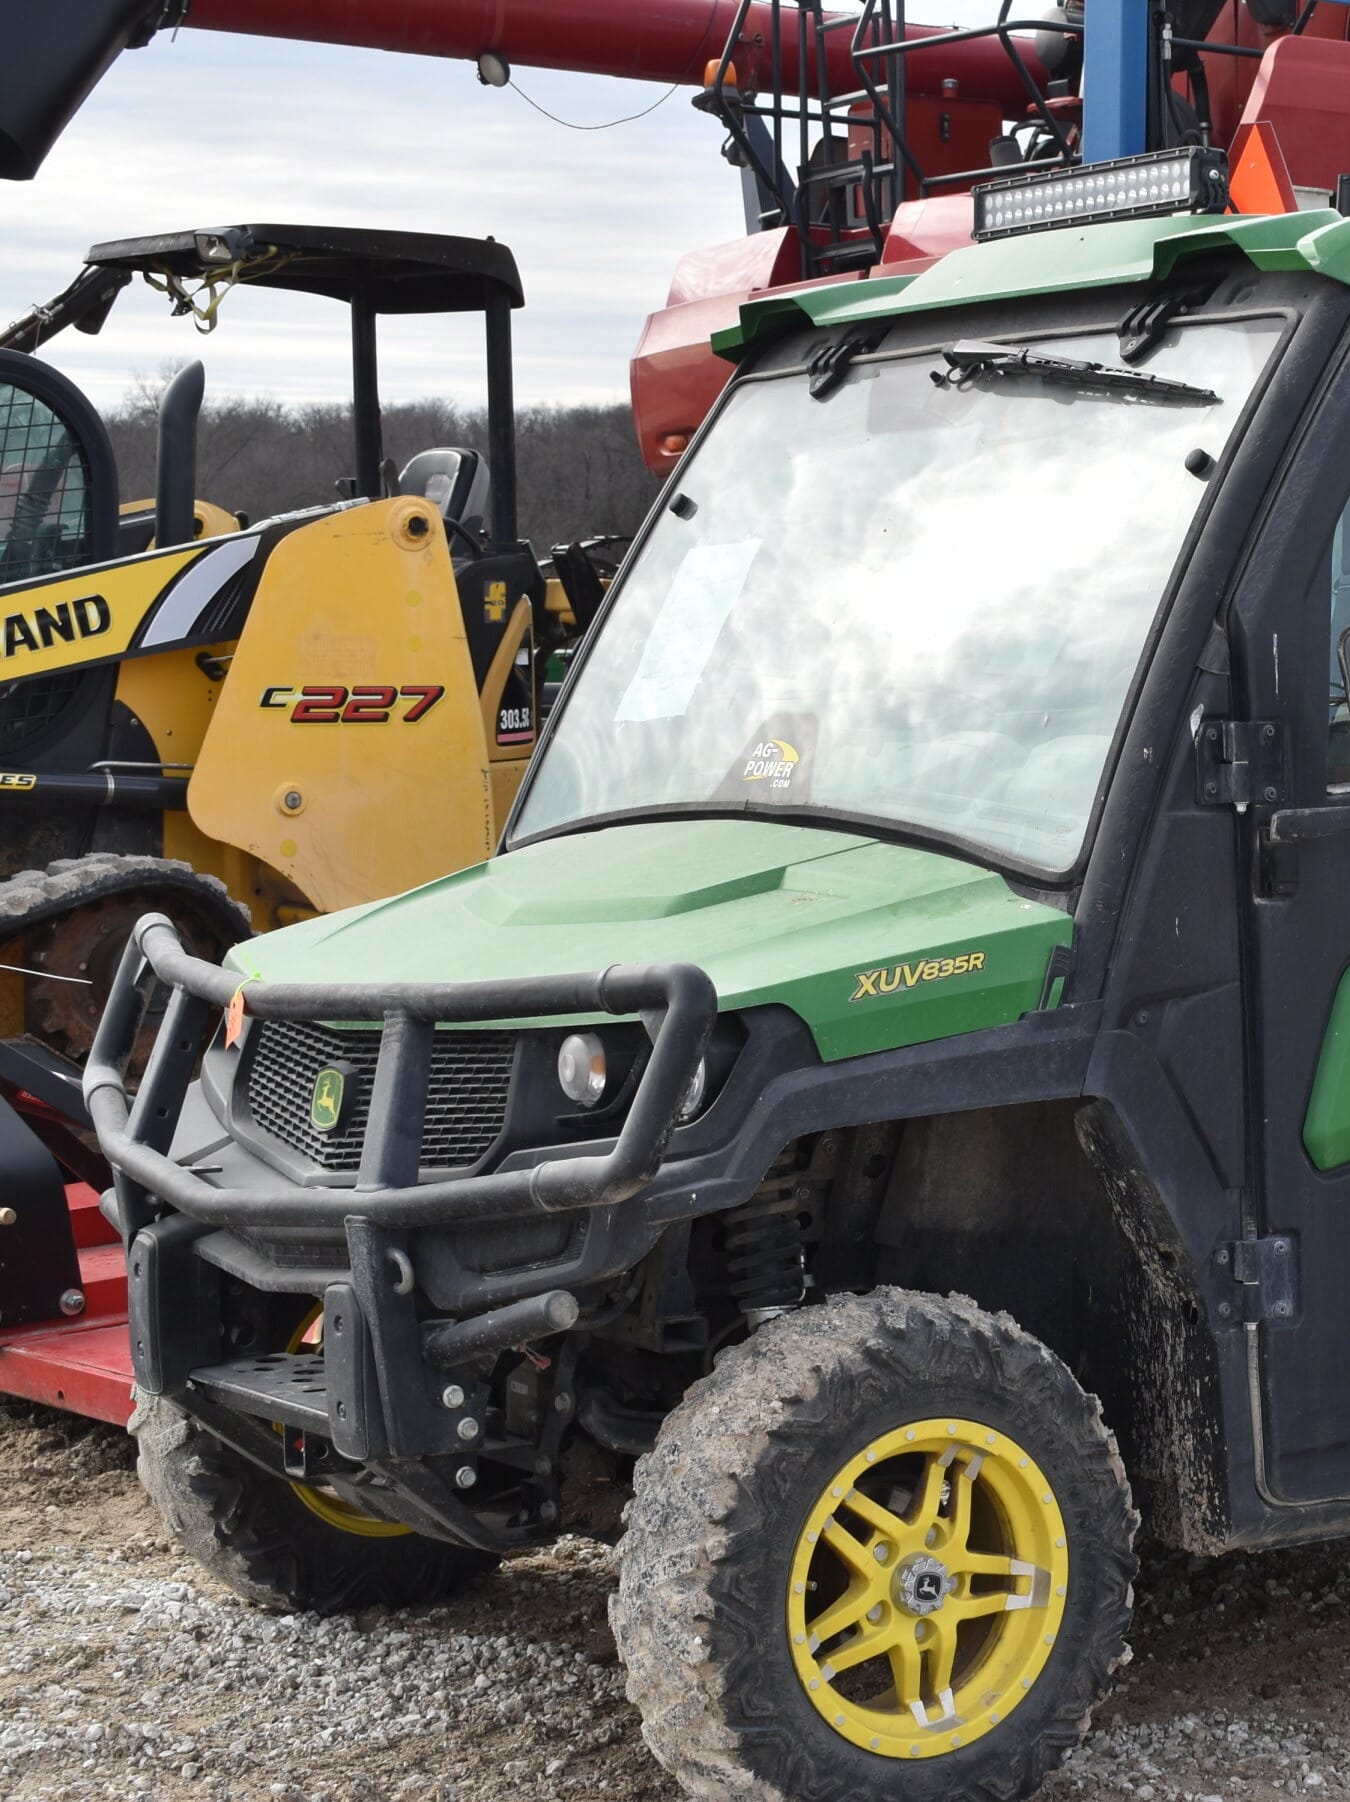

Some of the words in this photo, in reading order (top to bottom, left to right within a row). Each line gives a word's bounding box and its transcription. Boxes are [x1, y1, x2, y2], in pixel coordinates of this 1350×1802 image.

[3, 593, 112, 658] AND
[743, 760, 794, 777] POWER
[769, 779, 791, 788] .COM
[851, 951, 987, 1001] XUV835R
